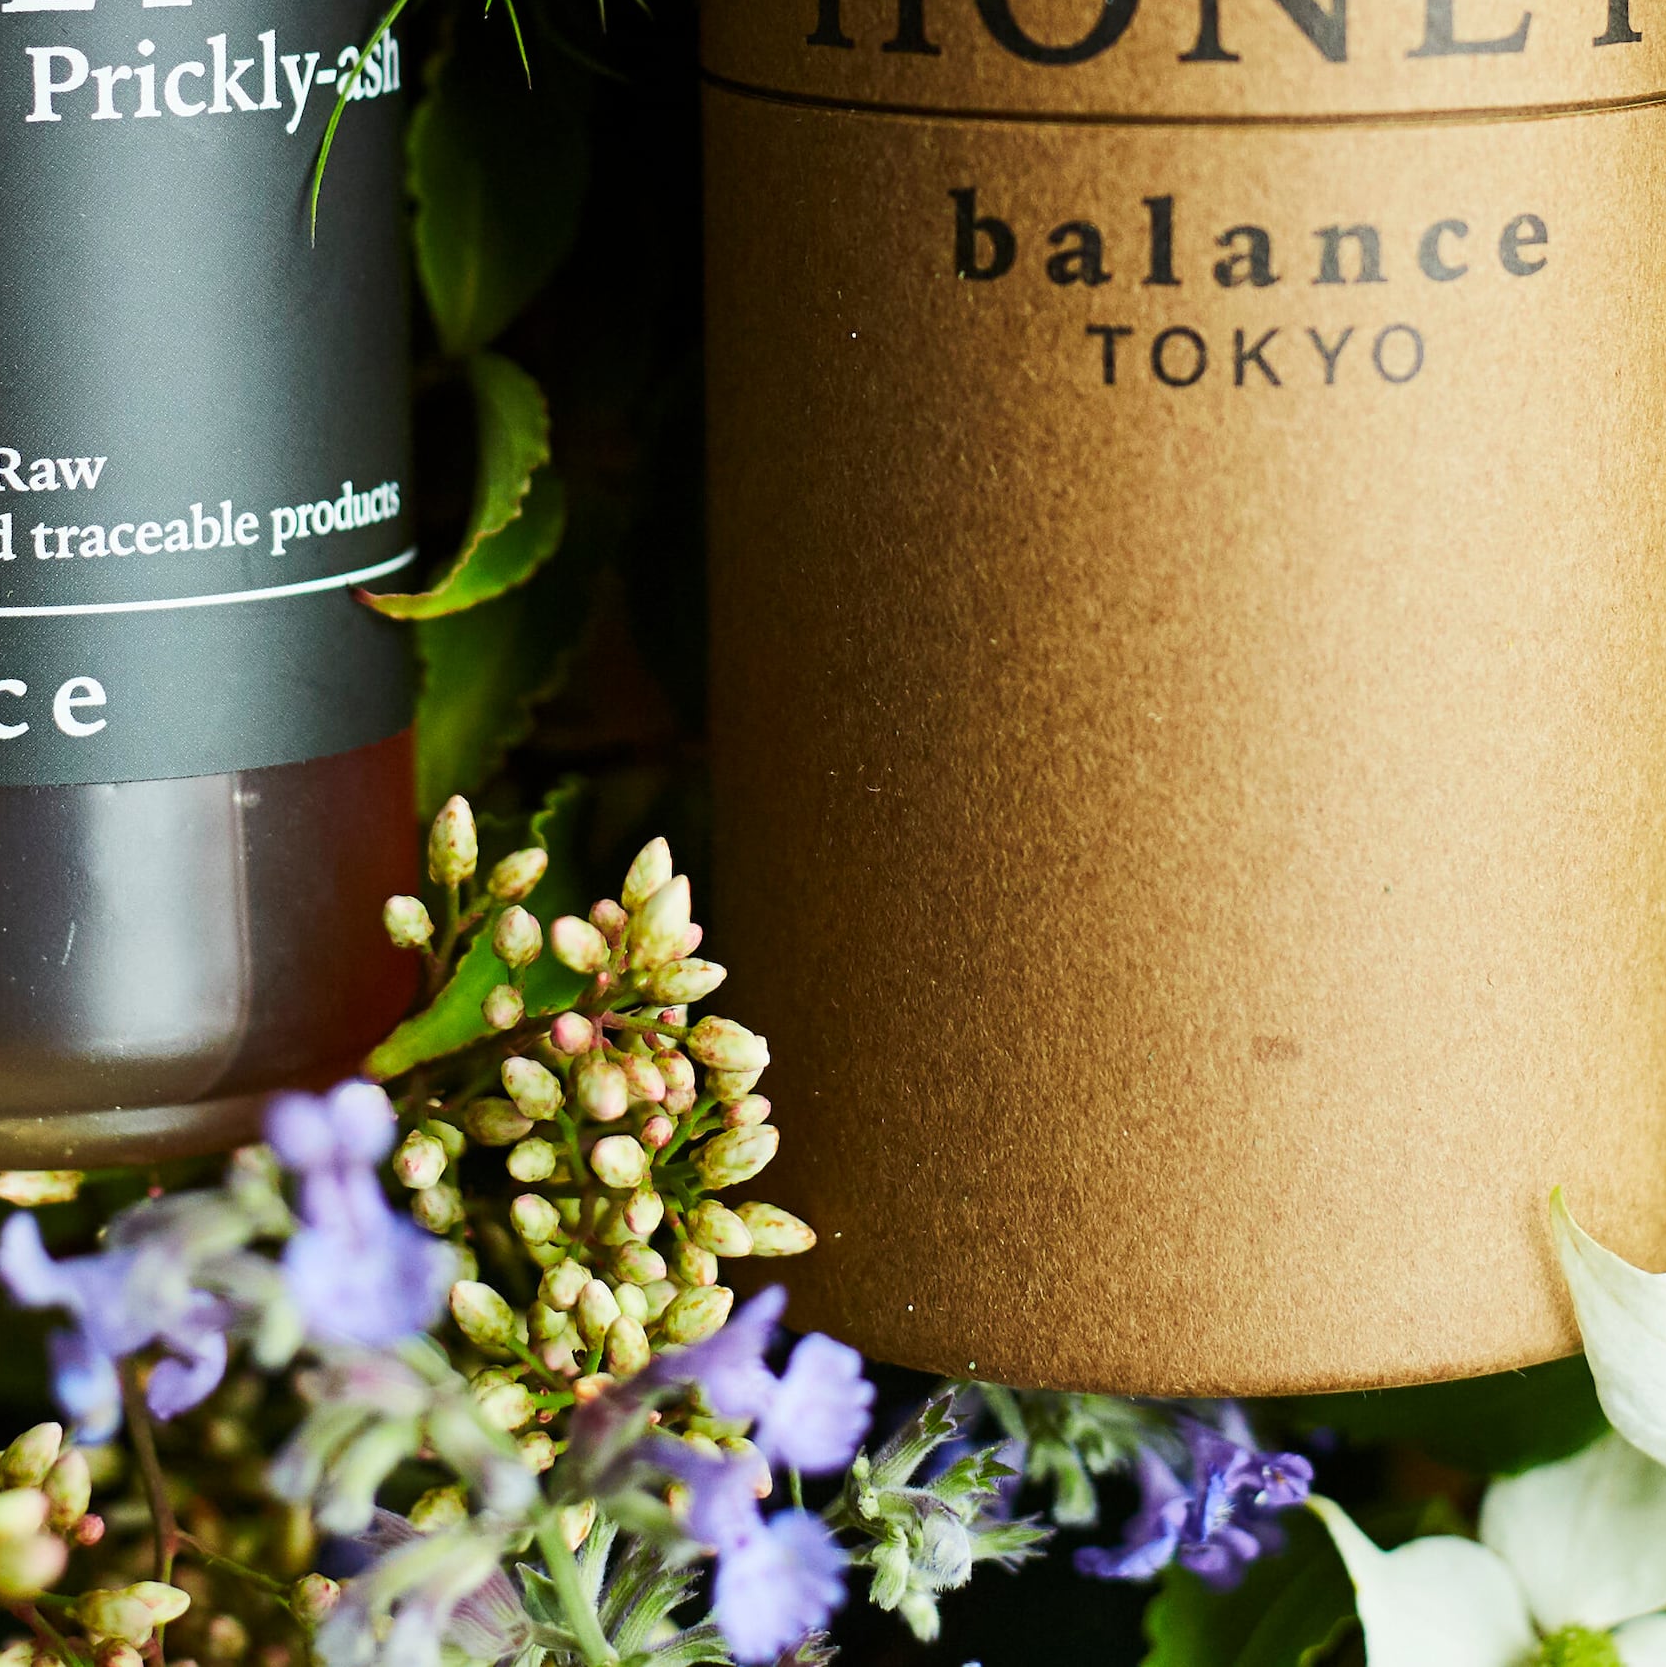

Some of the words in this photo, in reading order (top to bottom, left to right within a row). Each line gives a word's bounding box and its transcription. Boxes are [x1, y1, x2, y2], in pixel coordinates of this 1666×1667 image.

[25, 24, 402, 135] Prickly-ash
[947, 187, 1550, 288] balance
[1085, 323, 1426, 387] TOKYO
[31, 501, 261, 560] traceable
[270, 477, 401, 557] products
